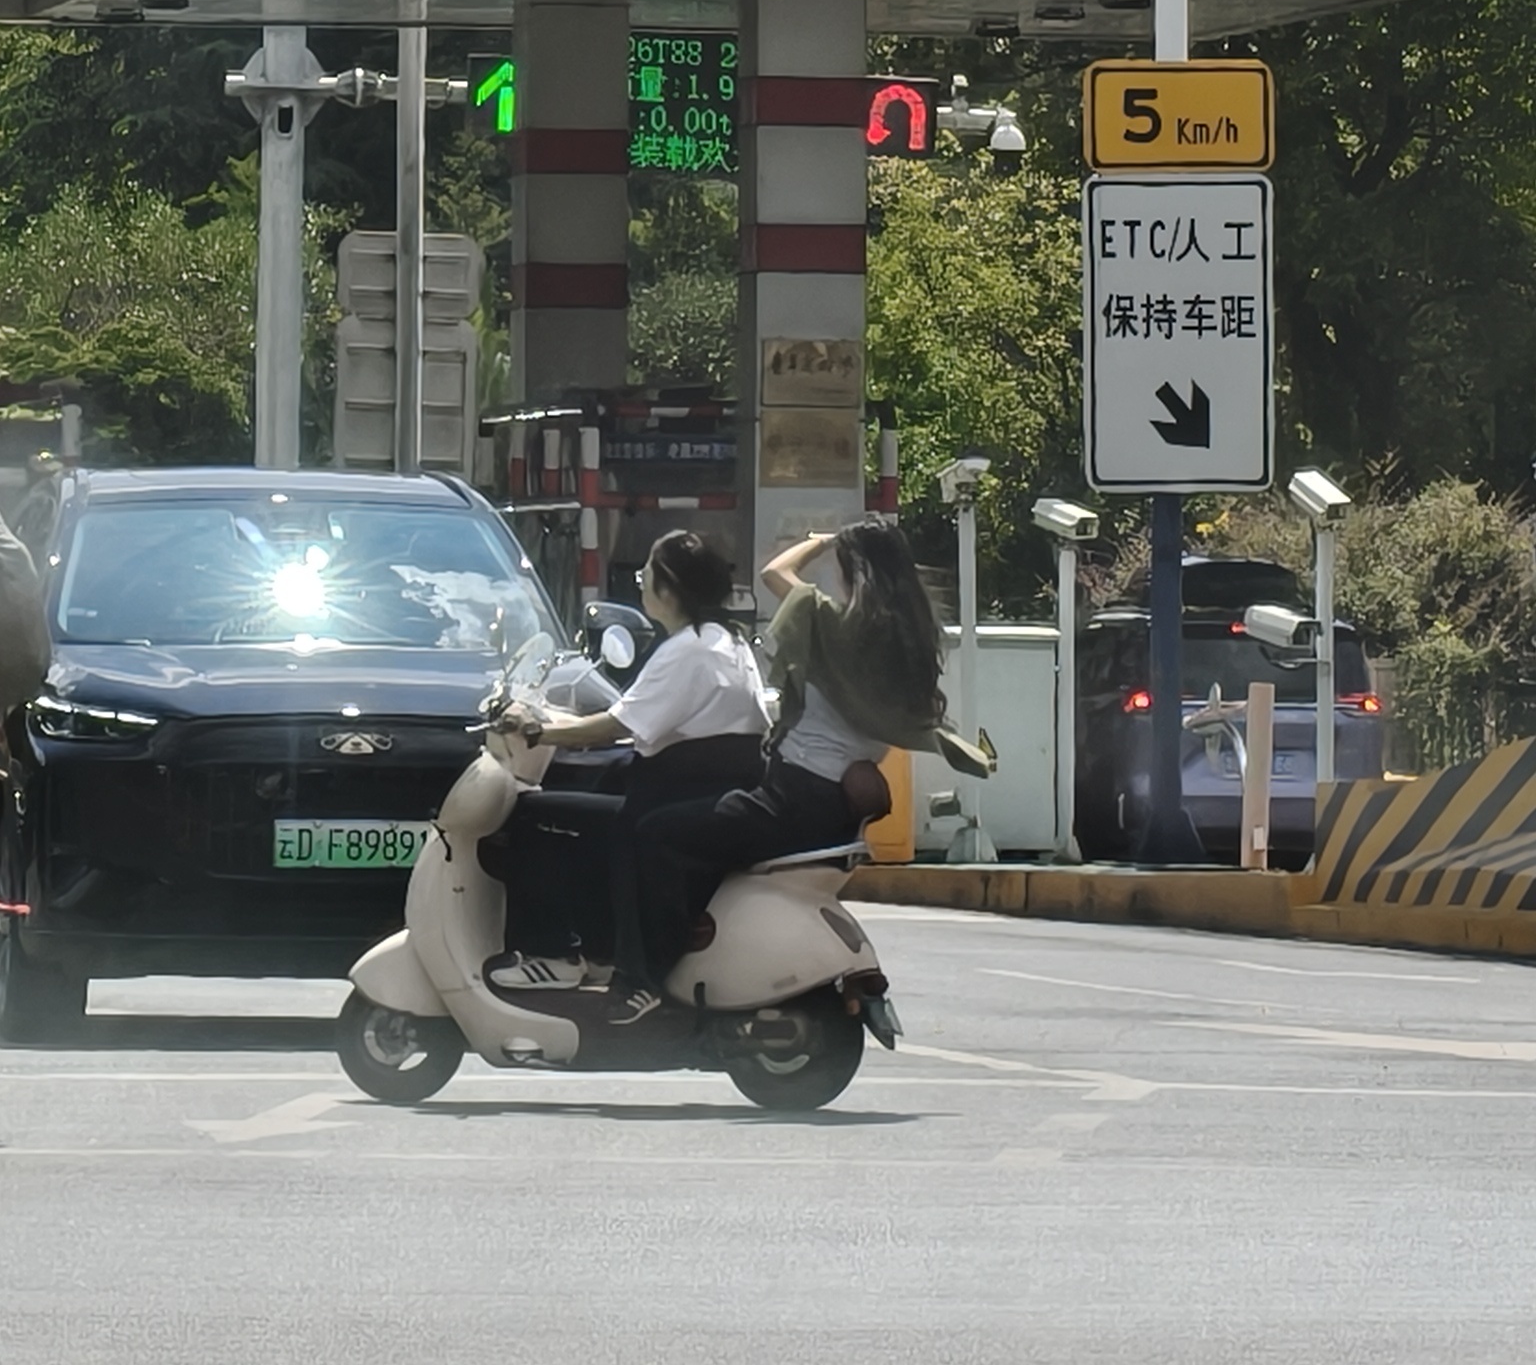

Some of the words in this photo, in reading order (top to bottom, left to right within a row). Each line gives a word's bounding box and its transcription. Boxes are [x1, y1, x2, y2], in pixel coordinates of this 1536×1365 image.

[1123, 88, 1162, 143] 5
[1177, 117, 1239, 145] Km/h
[1102, 293, 1257, 340] 保持车距
